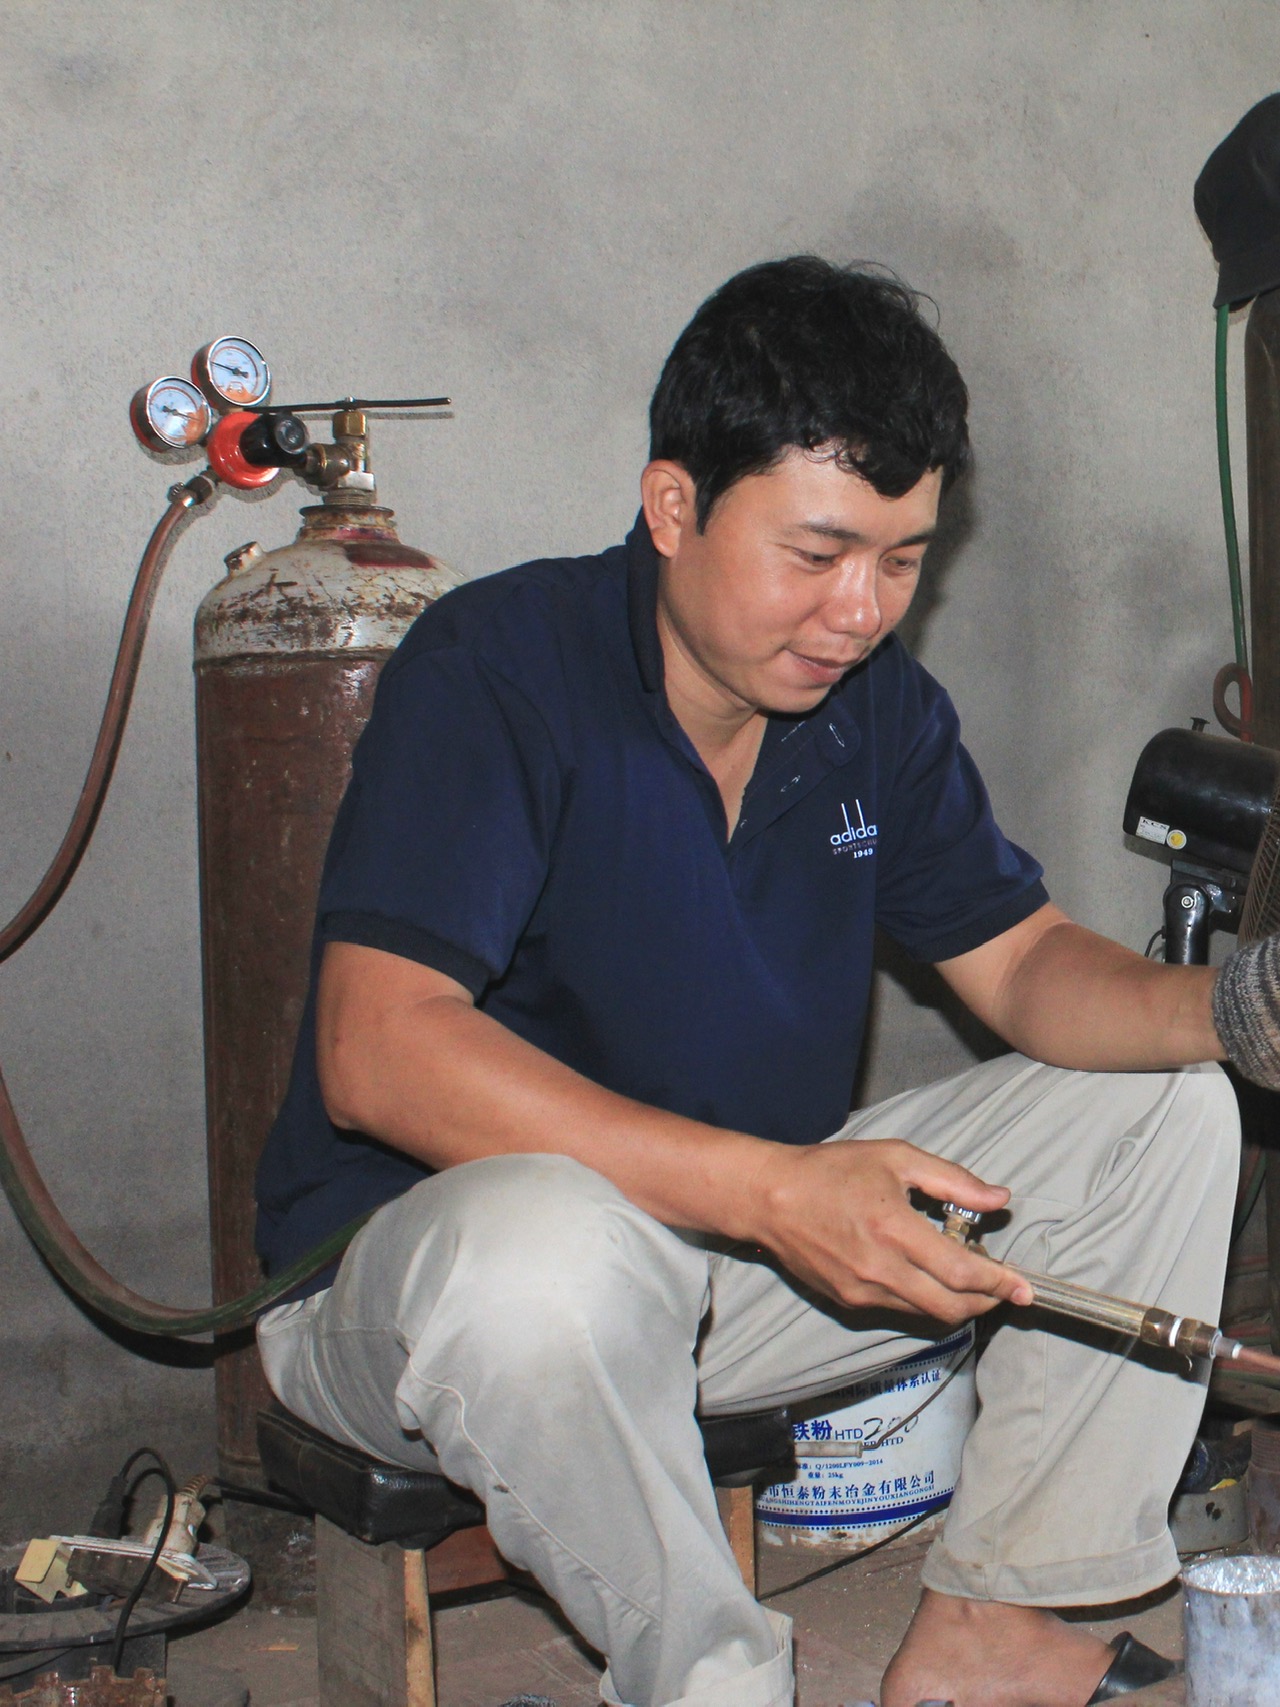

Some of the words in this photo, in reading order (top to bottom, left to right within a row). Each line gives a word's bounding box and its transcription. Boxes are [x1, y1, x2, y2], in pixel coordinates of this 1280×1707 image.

[853, 847, 873, 859] 1949
[834, 1428, 864, 1441] HTD
[765, 1470, 934, 1500] 市恒泰粉末冶金有限公司
